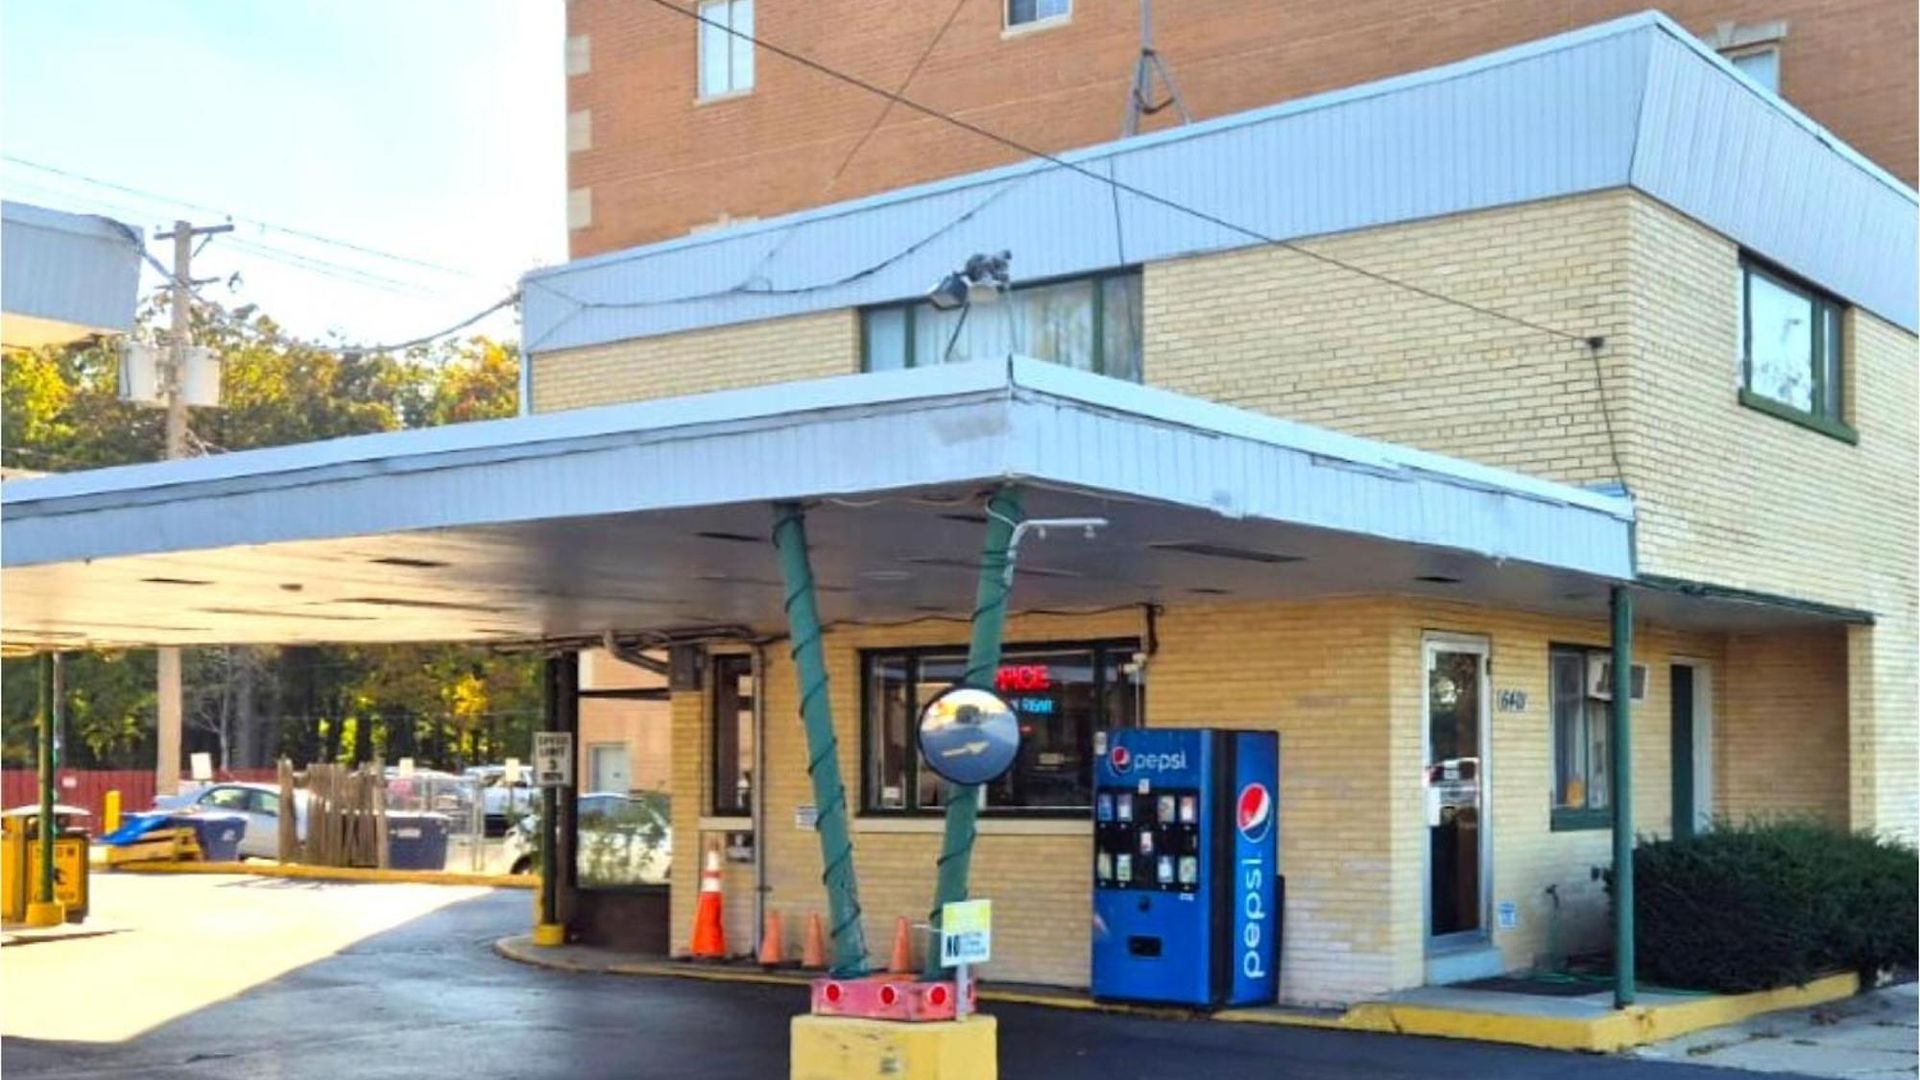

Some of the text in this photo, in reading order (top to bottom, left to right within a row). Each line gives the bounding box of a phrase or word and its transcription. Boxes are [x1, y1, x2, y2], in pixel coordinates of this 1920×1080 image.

[1133, 749, 1187, 773] pepsi
[1241, 858, 1266, 979] pepsi
[945, 934, 960, 957] NO
